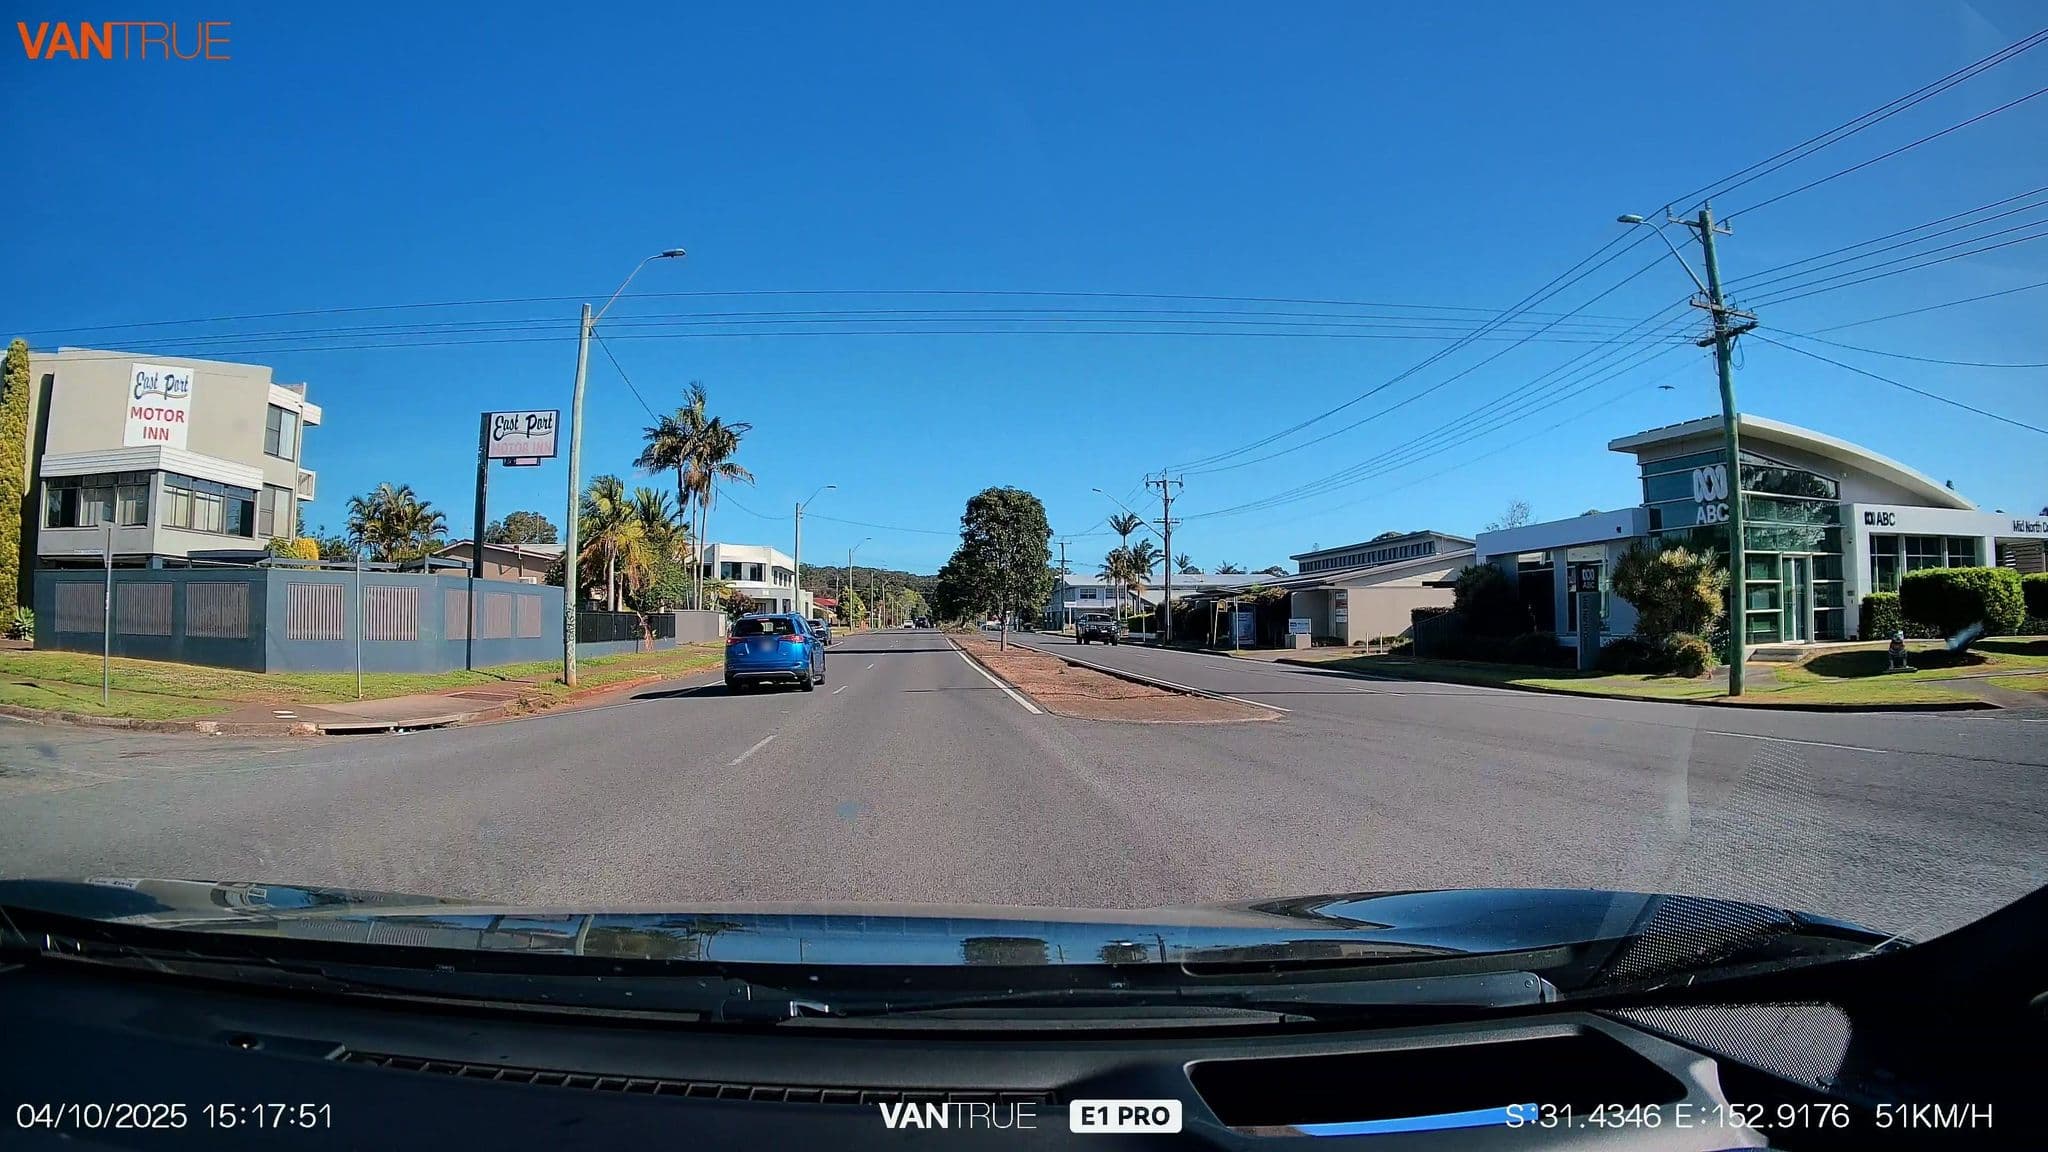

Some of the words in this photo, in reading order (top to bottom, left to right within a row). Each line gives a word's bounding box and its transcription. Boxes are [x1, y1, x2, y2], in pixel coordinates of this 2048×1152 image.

[134, 371, 158, 400] East
[164, 373, 189, 400] Port
[130, 406, 185, 423] MOTOR
[143, 426, 169, 441] INN
[493, 414, 519, 441] East
[525, 413, 553, 439] Port
[1696, 502, 1730, 525] ABC
[1876, 511, 1896, 527] ABC
[2013, 519, 2024, 532] Mid
